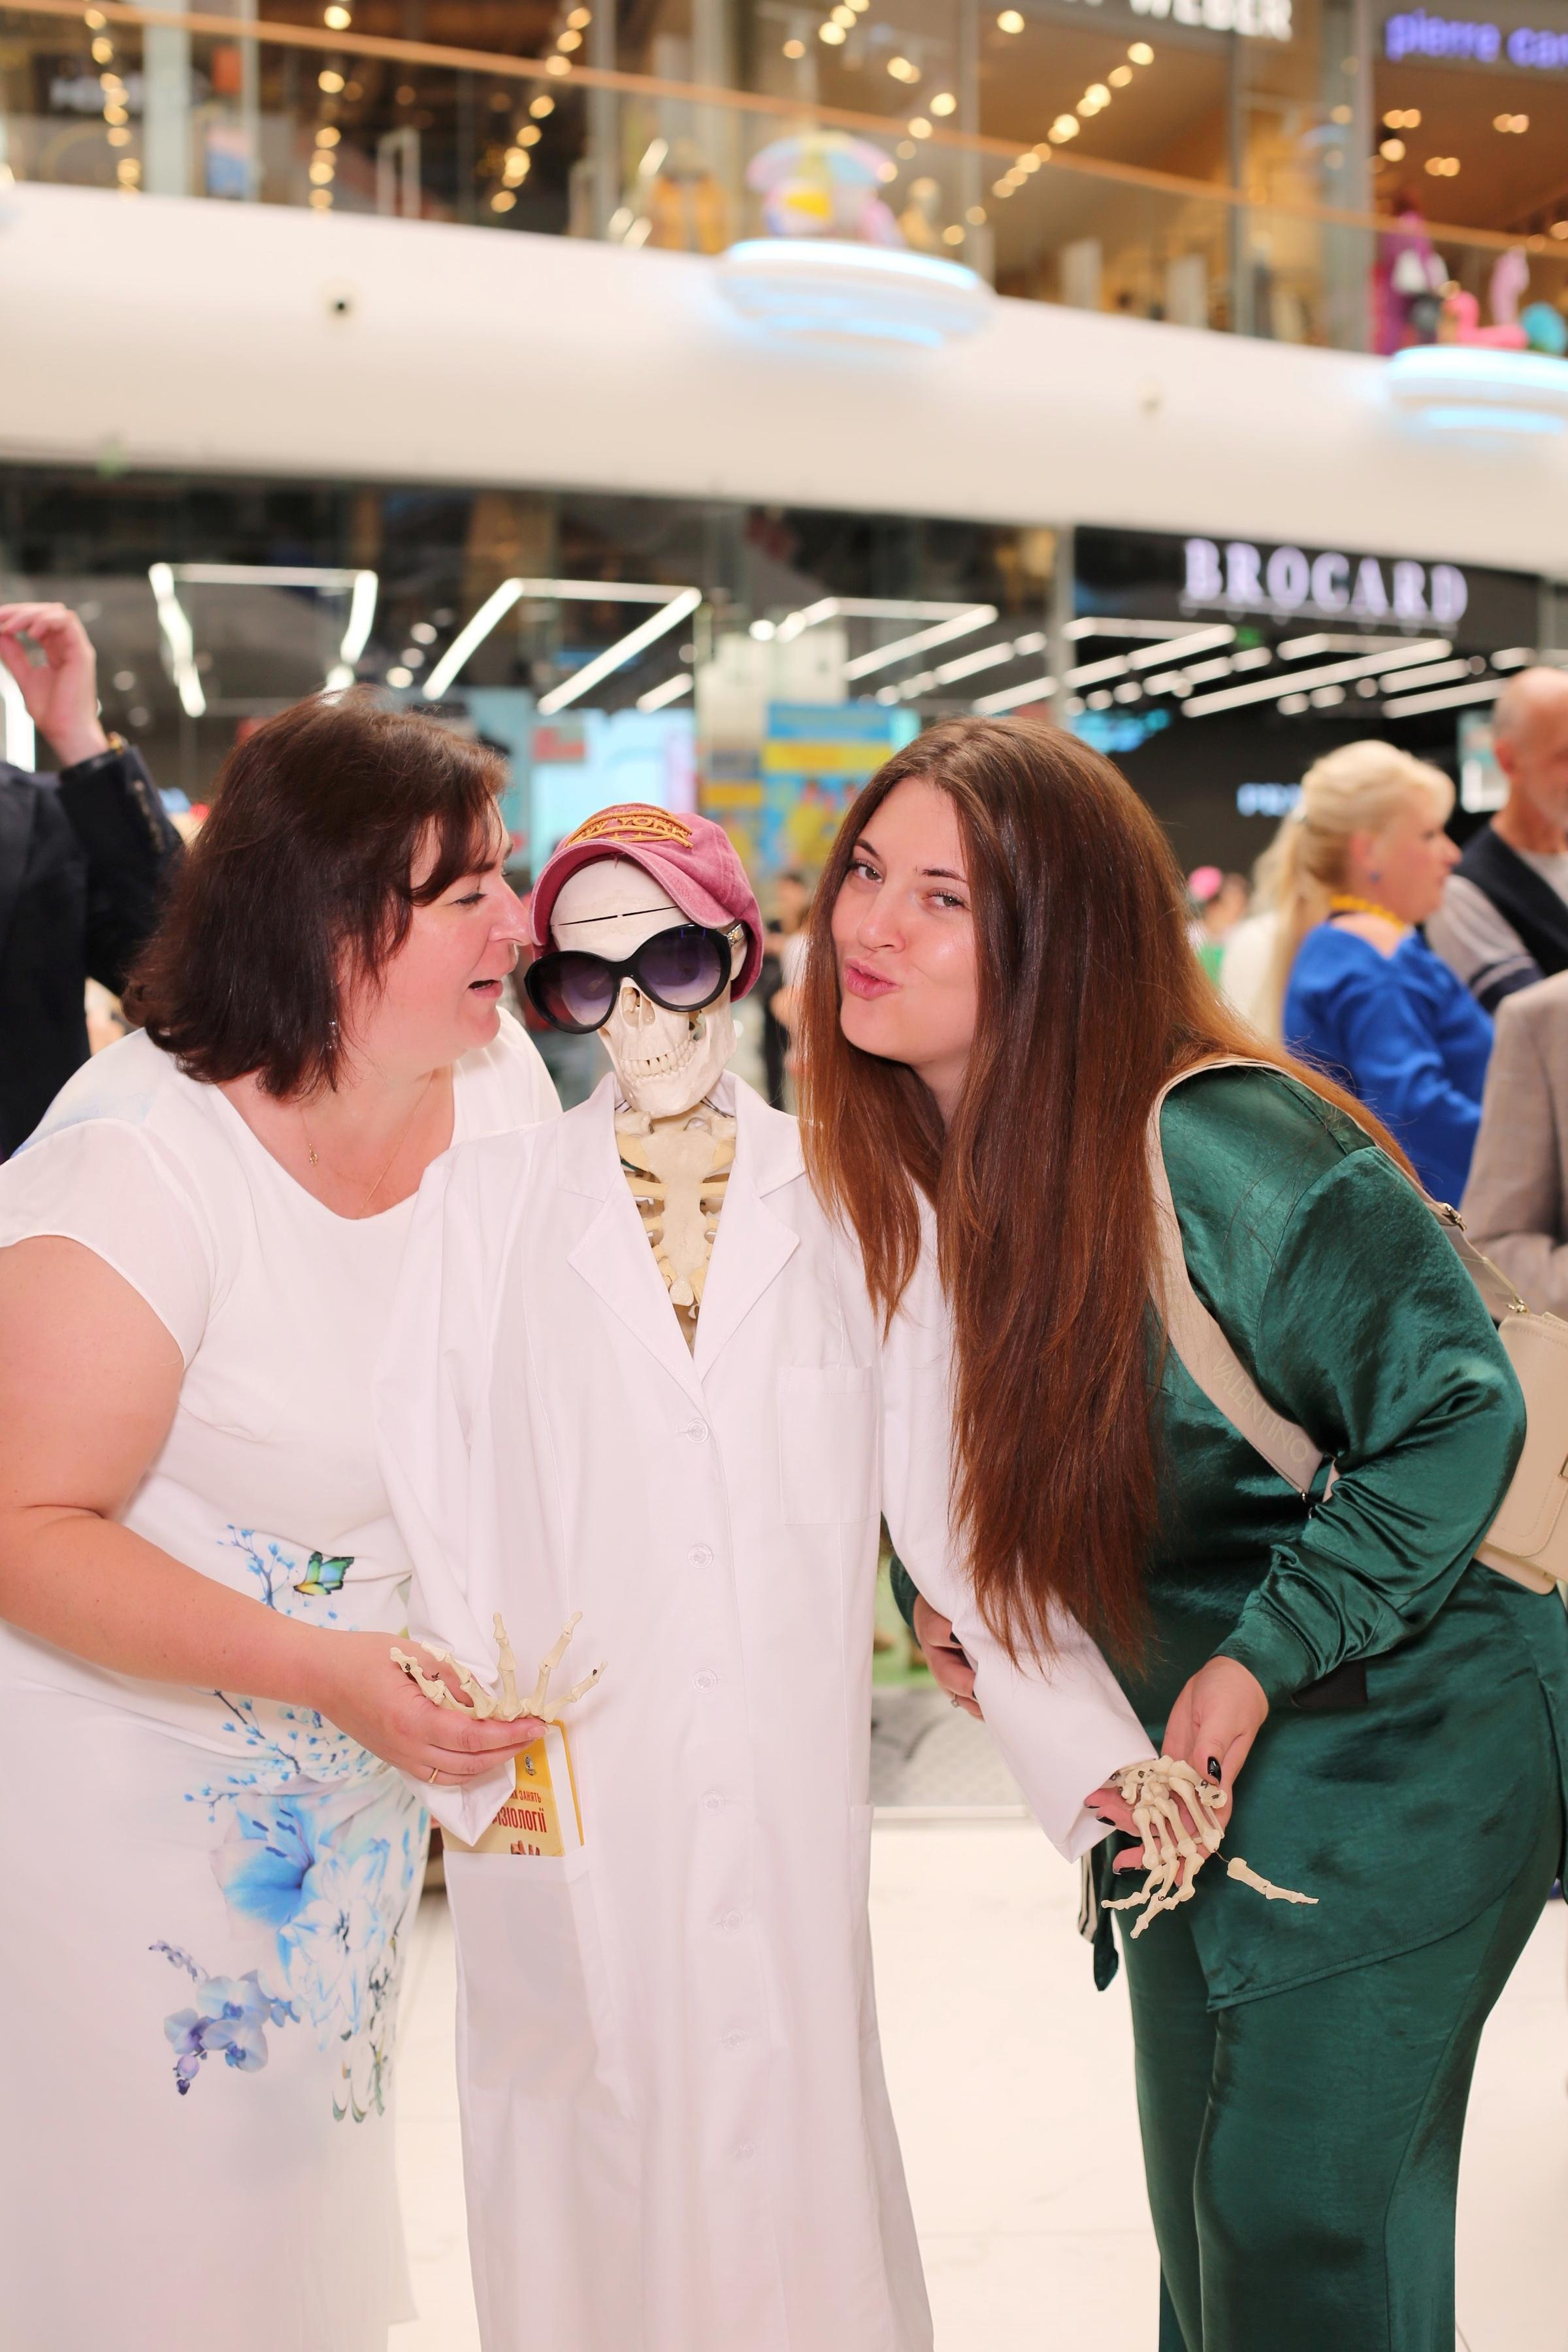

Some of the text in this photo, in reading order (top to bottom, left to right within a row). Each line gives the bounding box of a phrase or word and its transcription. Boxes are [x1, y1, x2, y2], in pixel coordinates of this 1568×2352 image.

[1185, 538, 1468, 623] BROCARD
[617, 816, 689, 838] YORK
[1212, 1352, 1309, 1463] VALENTINO
[519, 1790, 542, 1803] ЗАНЯТЬ
[493, 1806, 547, 1833] ІЗІОЛОГІЇ
